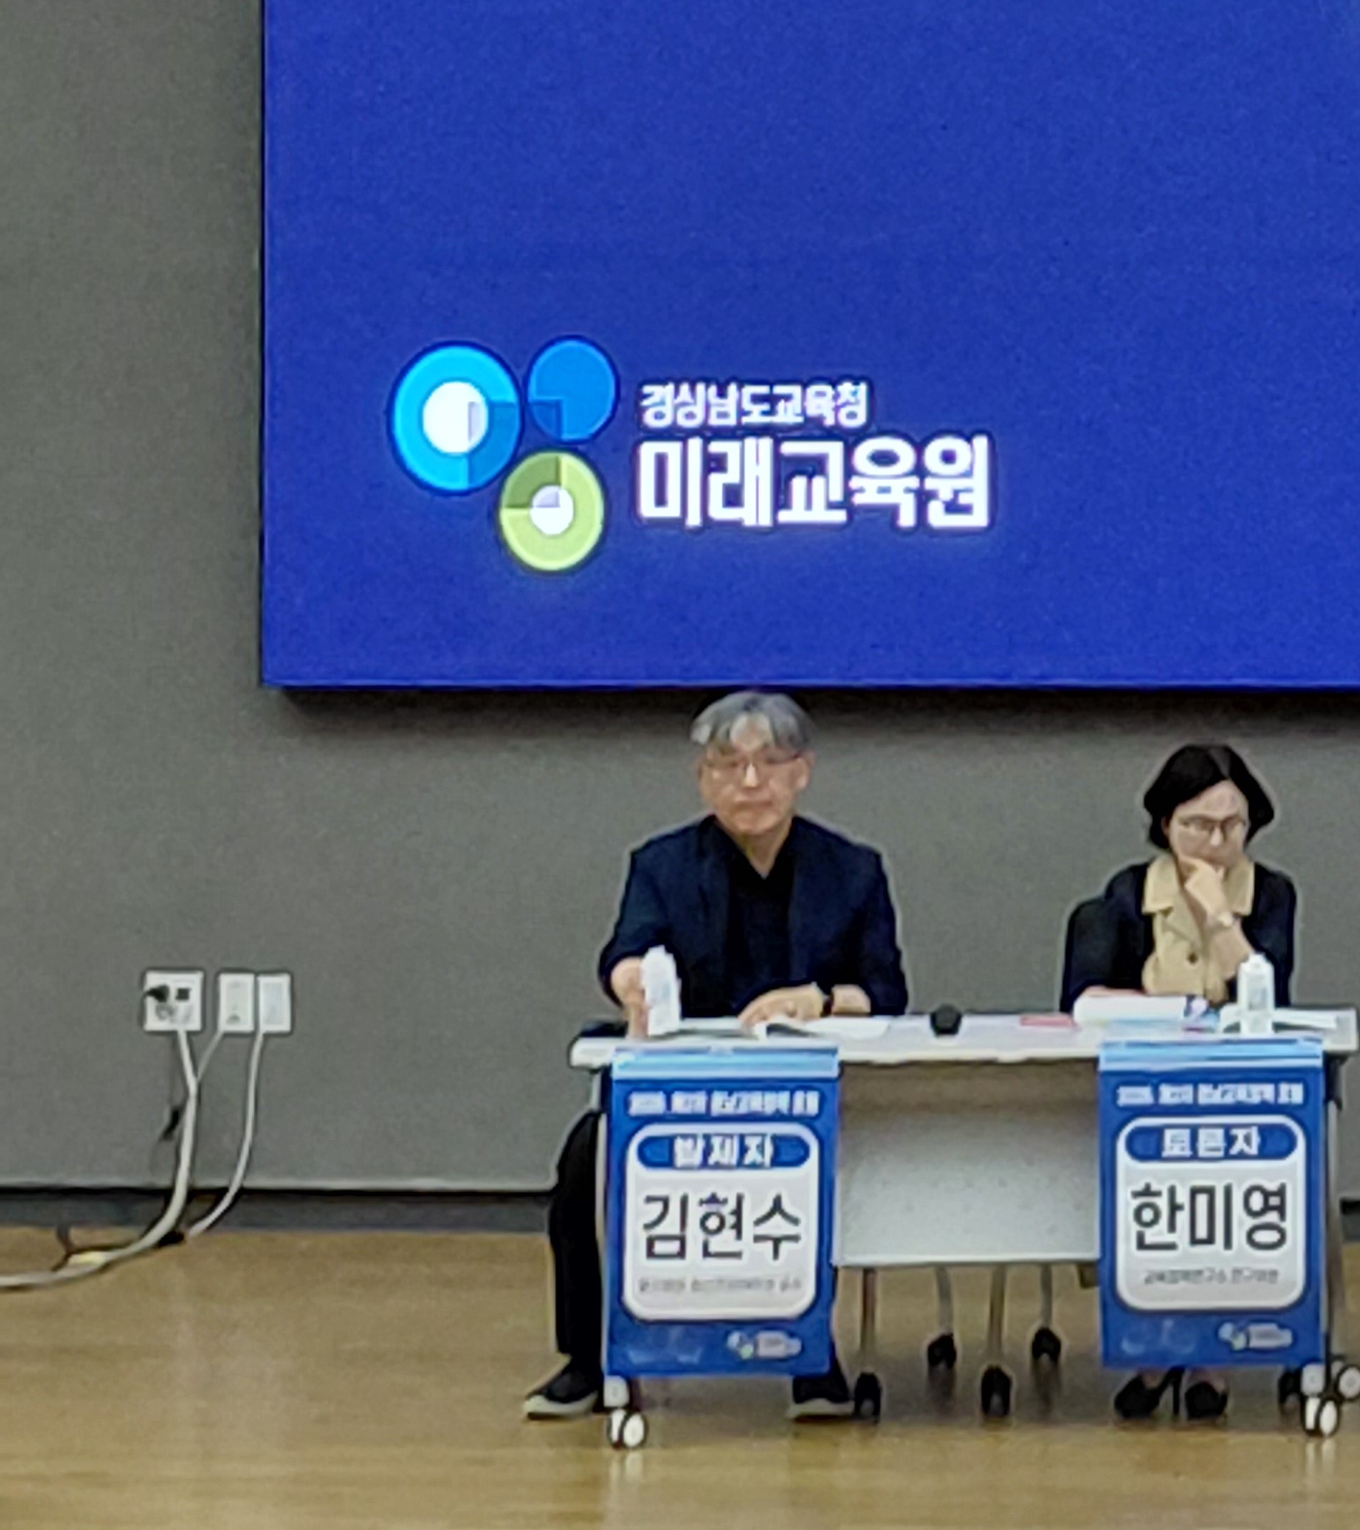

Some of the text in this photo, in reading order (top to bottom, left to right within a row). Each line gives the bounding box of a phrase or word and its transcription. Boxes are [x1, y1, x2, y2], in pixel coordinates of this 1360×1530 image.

[640, 381, 868, 428] 경상남도교육청
[637, 434, 990, 529] 미래교육원
[643, 1192, 802, 1260] 김현수
[1131, 1183, 1288, 1251] 한미영
